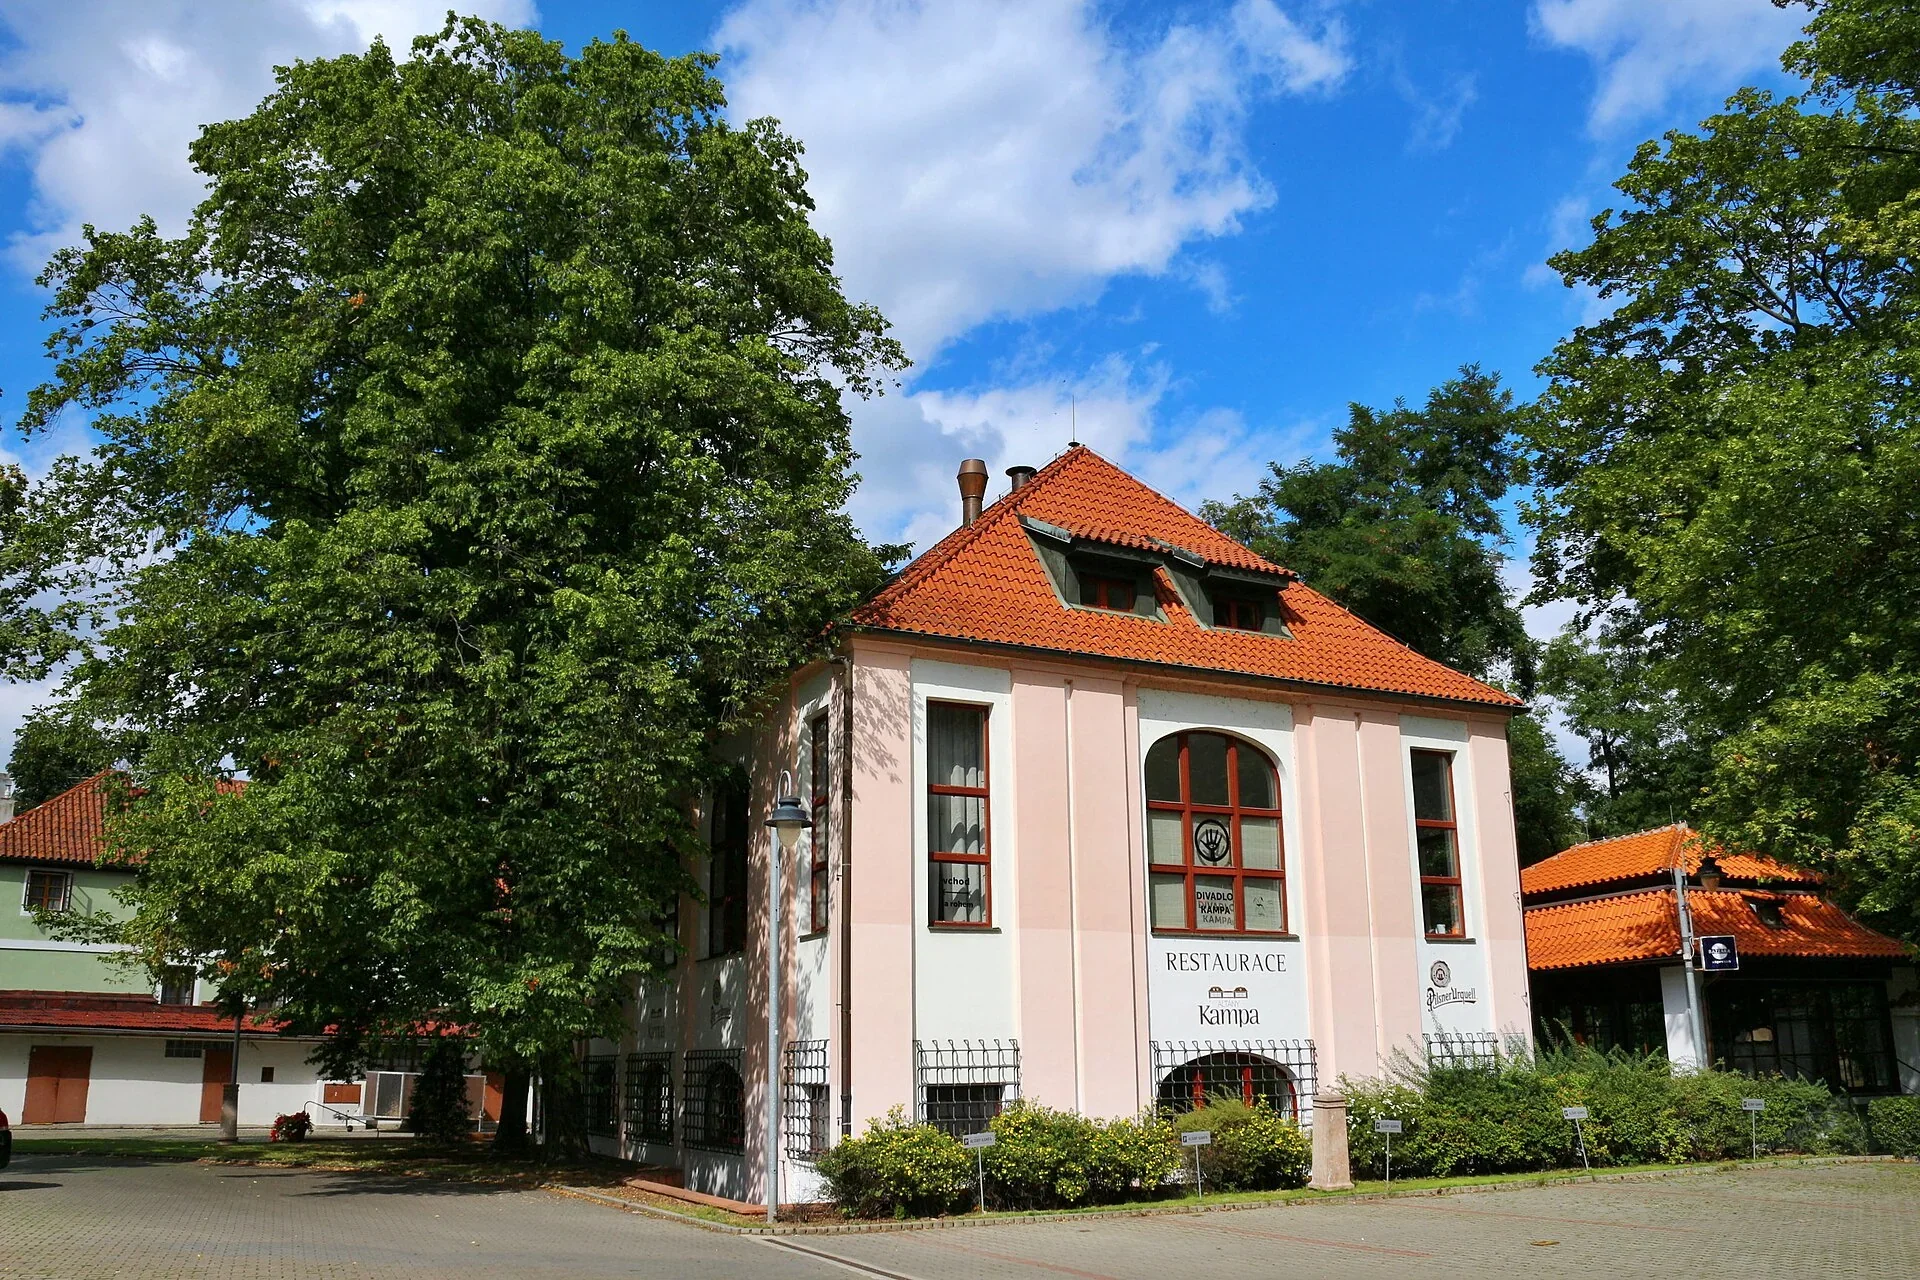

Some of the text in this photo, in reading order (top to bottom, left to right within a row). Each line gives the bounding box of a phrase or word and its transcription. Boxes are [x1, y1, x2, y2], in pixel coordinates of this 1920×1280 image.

[1196, 891, 1234, 901] DIVADLO
[1200, 905, 1231, 915] KAMPA
[1166, 952, 1287, 973] RESTAURACE
[1426, 987, 1476, 1012] Pilsner Urquell
[1198, 1005, 1260, 1028] Kampa
